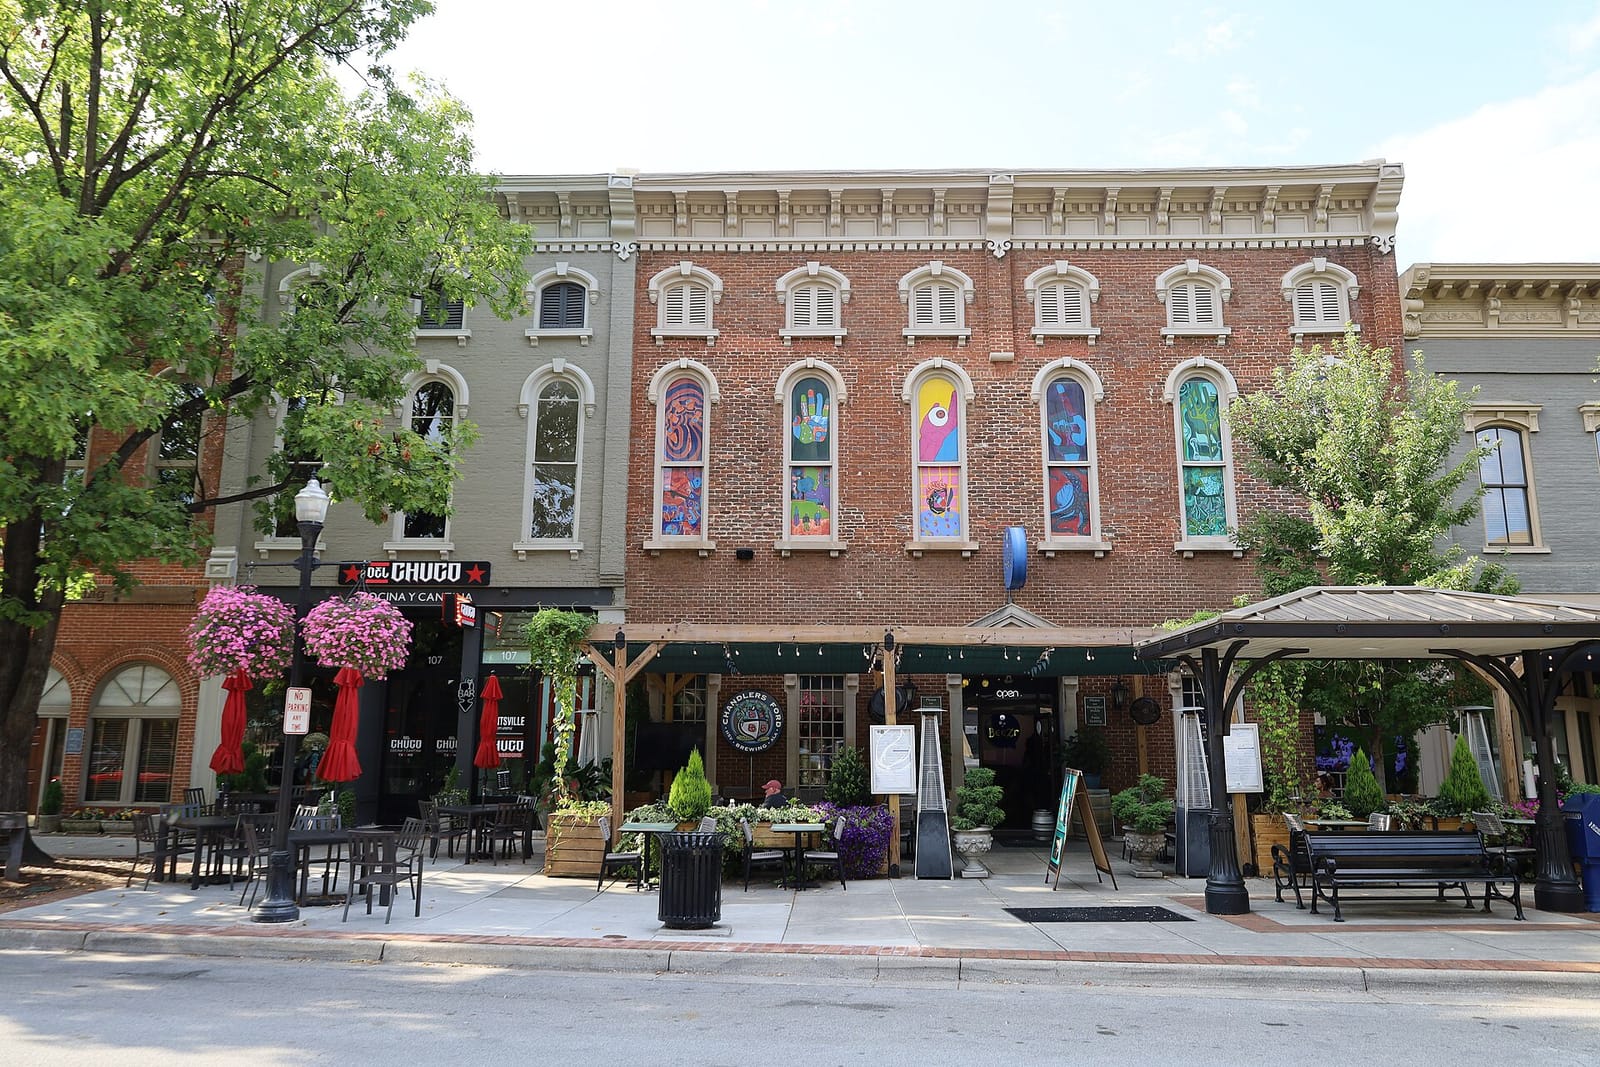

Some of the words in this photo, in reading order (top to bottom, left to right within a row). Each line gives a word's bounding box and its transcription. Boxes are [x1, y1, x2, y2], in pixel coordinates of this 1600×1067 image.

[391, 562, 461, 582] CHUCO
[409, 592, 416, 602] Y
[428, 655, 443, 665] 107
[501, 651, 518, 661] 107
[294, 691, 304, 701] NO
[458, 689, 474, 698] BAR
[996, 689, 1019, 699] open
[287, 703, 309, 712] PARKING
[722, 691, 768, 725] CHANDLERS
[769, 702, 782, 728] FORD
[390, 739, 422, 749] CHUCO
